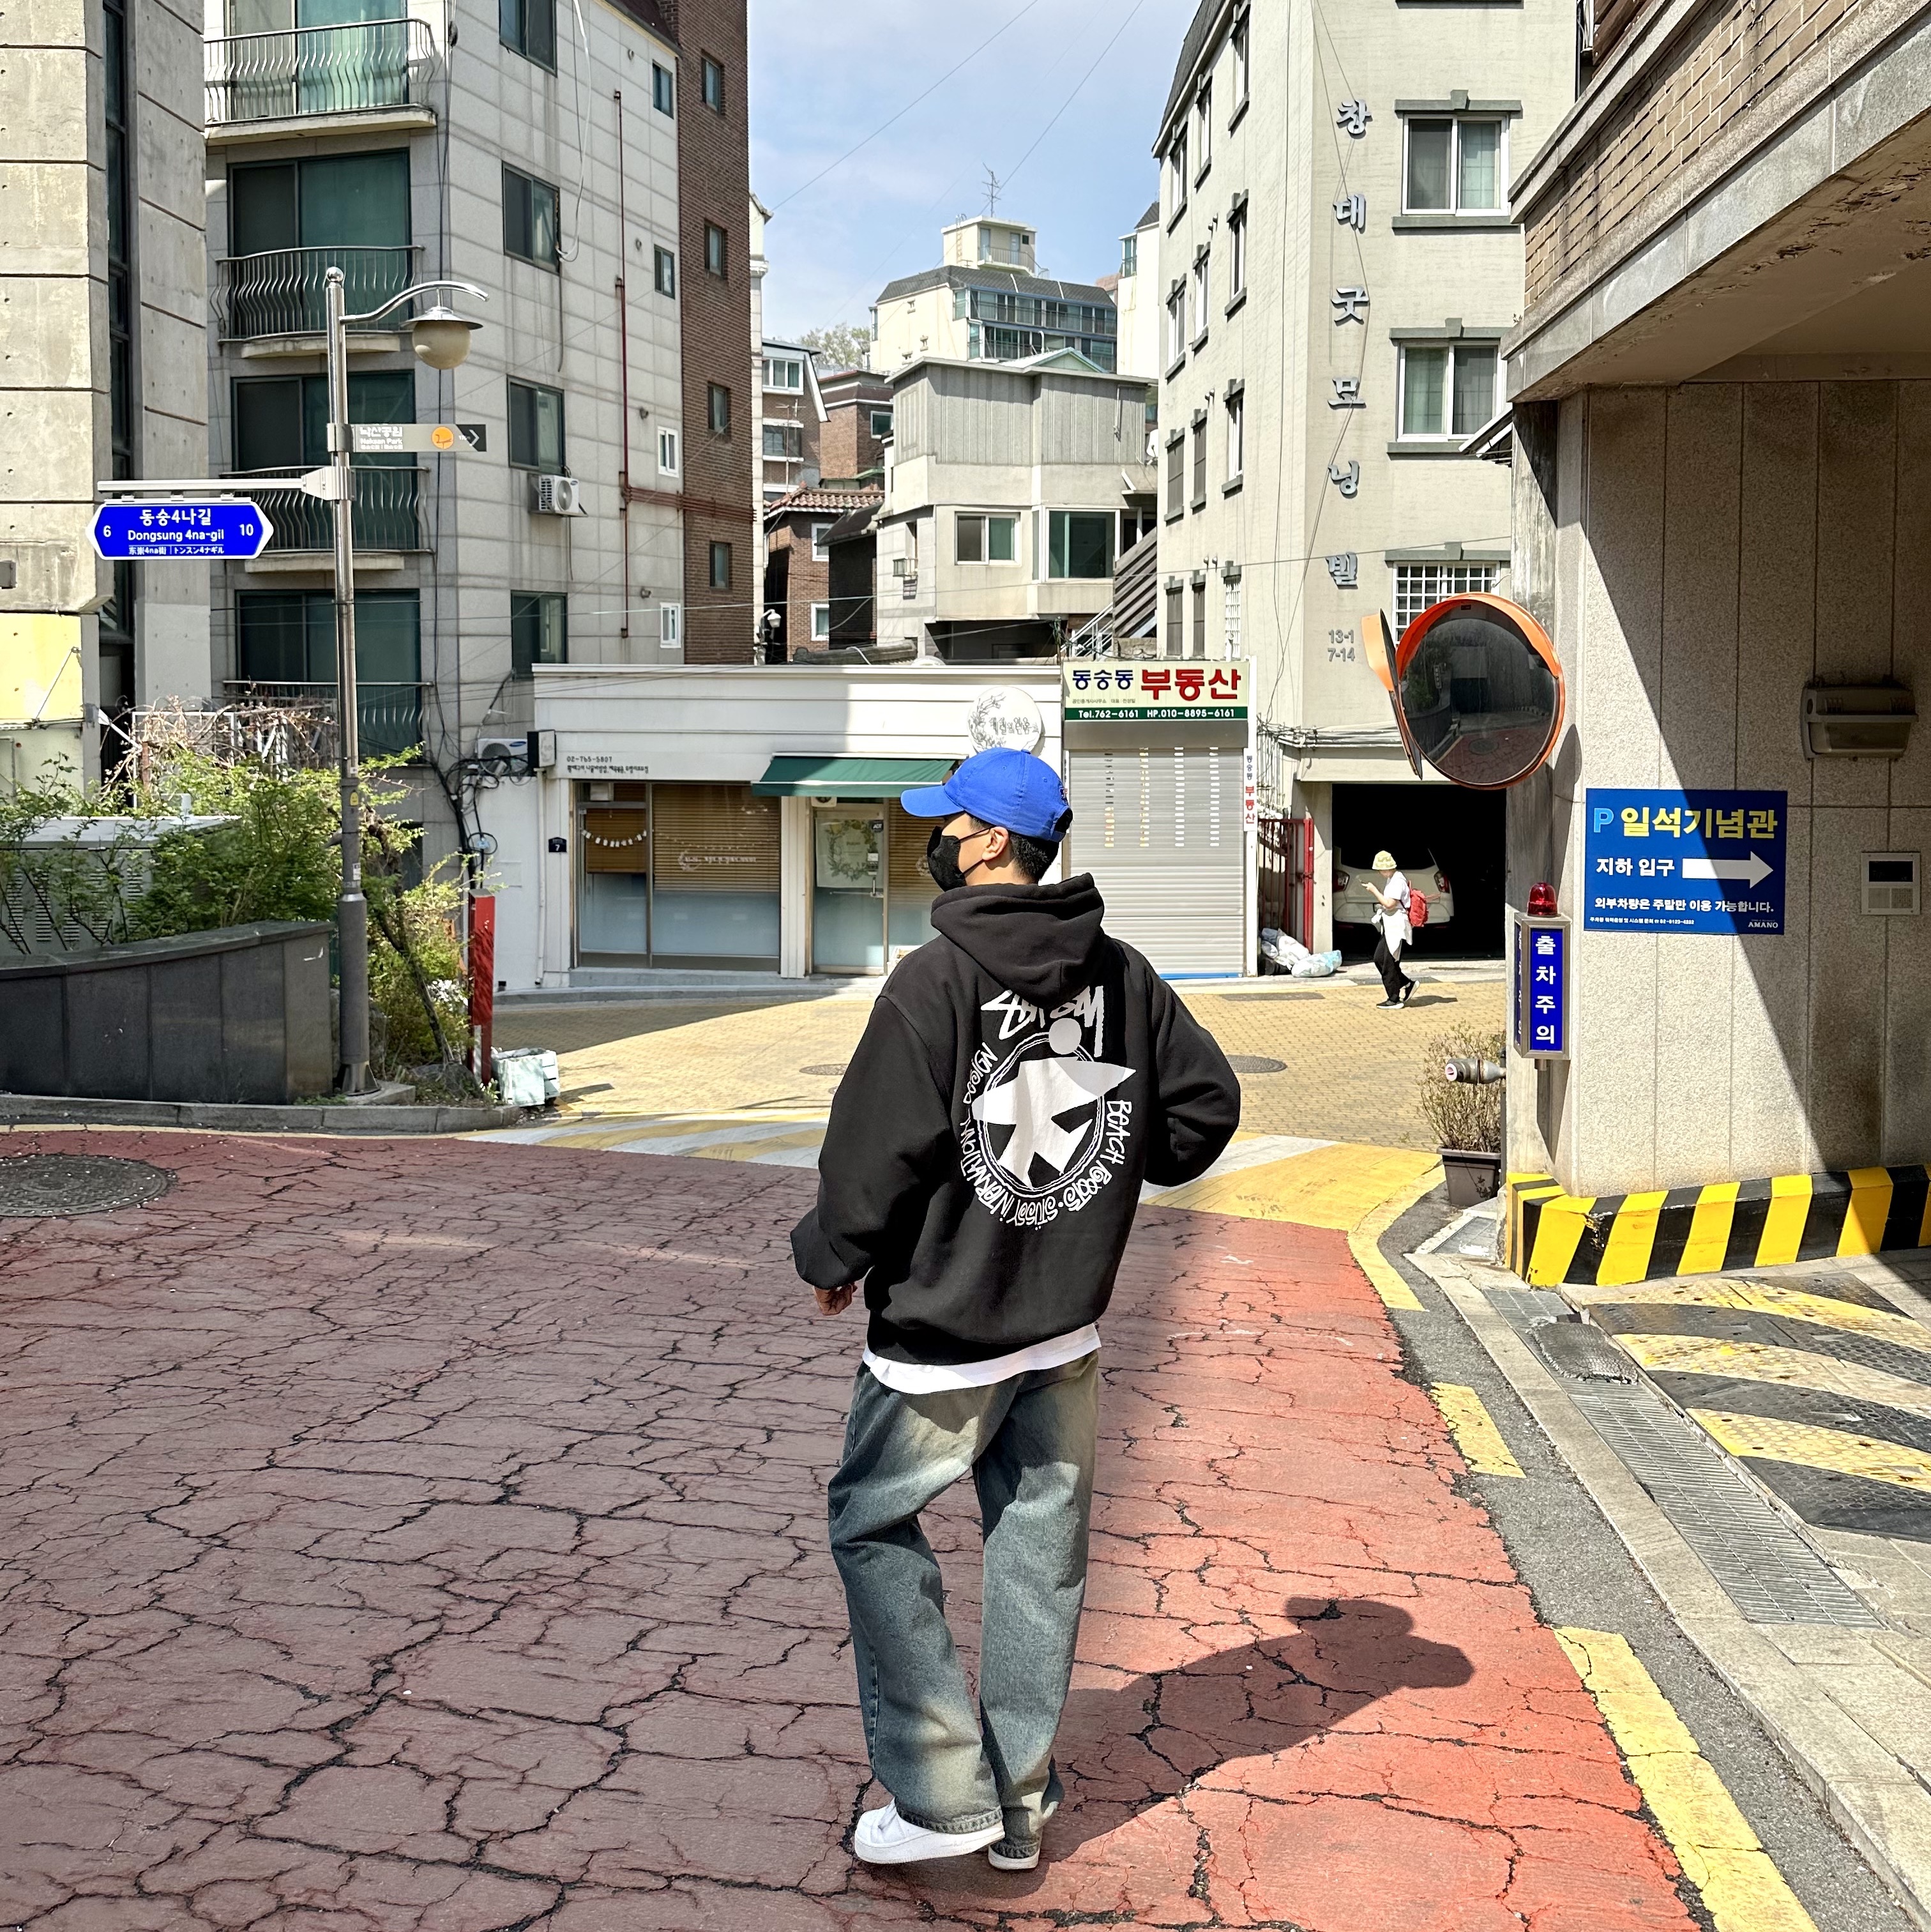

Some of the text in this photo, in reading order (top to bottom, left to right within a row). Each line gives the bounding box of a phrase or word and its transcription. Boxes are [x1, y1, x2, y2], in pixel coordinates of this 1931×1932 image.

[139, 508, 211, 526] 동숭4나길
[103, 525, 112, 537] 6
[128, 529, 224, 542] Dongsung 4na-gil
[239, 524, 254, 536] 10
[1328, 629, 1354, 644] 13-1
[1328, 647, 1356, 662] 7-14
[1072, 669, 1241, 701] 동숭동 부동산
[1079, 708, 1235, 719] Tel.762-6161 HP.010-8895-6161
[1245, 786, 1255, 824] 부동산
[1593, 807, 1778, 839] P 일석기념관
[1596, 858, 1676, 877] 지하 입구
[1594, 897, 1775, 913] 외부차량은 주말만 이용 가능합니다.
